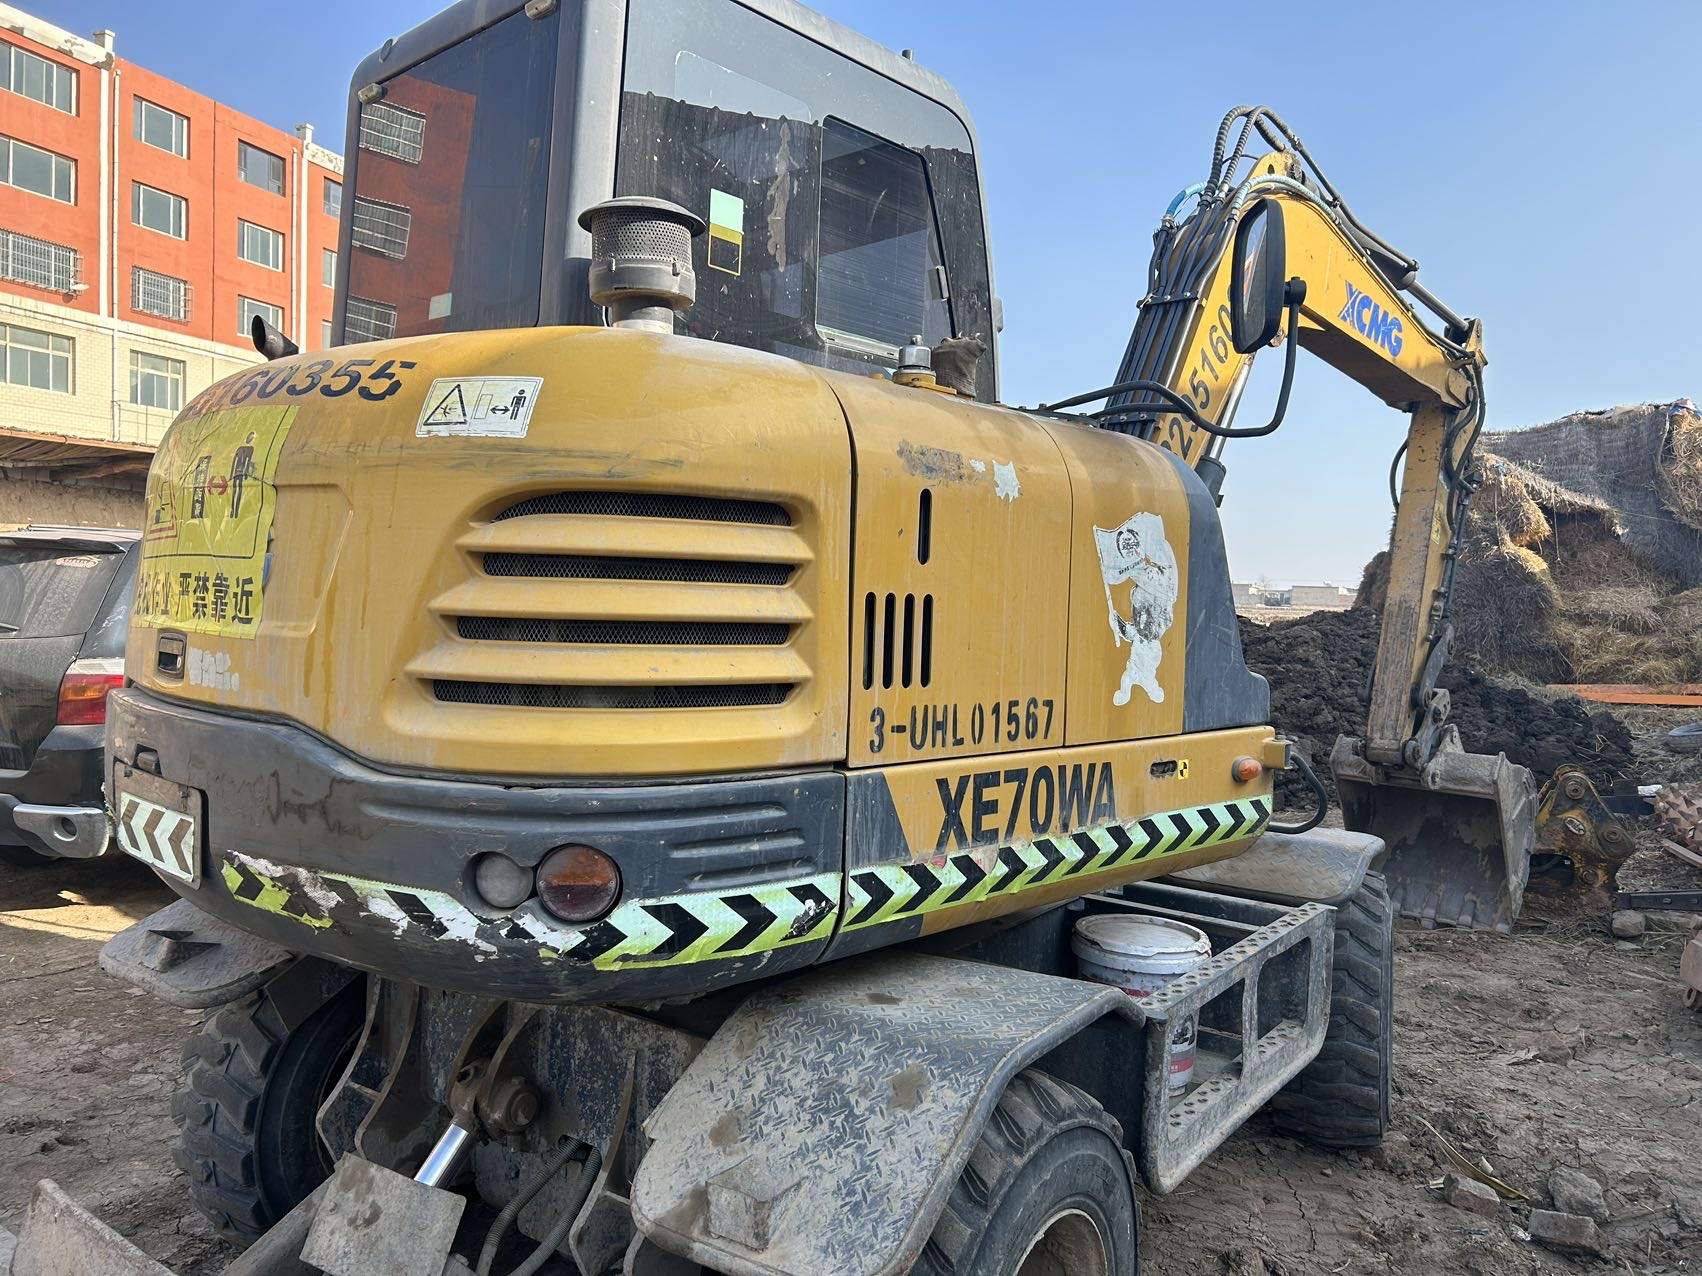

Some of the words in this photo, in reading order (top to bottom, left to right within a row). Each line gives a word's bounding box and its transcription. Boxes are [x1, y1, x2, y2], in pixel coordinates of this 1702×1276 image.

[1337, 280, 1402, 359] XCMG
[868, 696, 1055, 754] 3-UHL01567
[935, 761, 1117, 854] XE70WA
